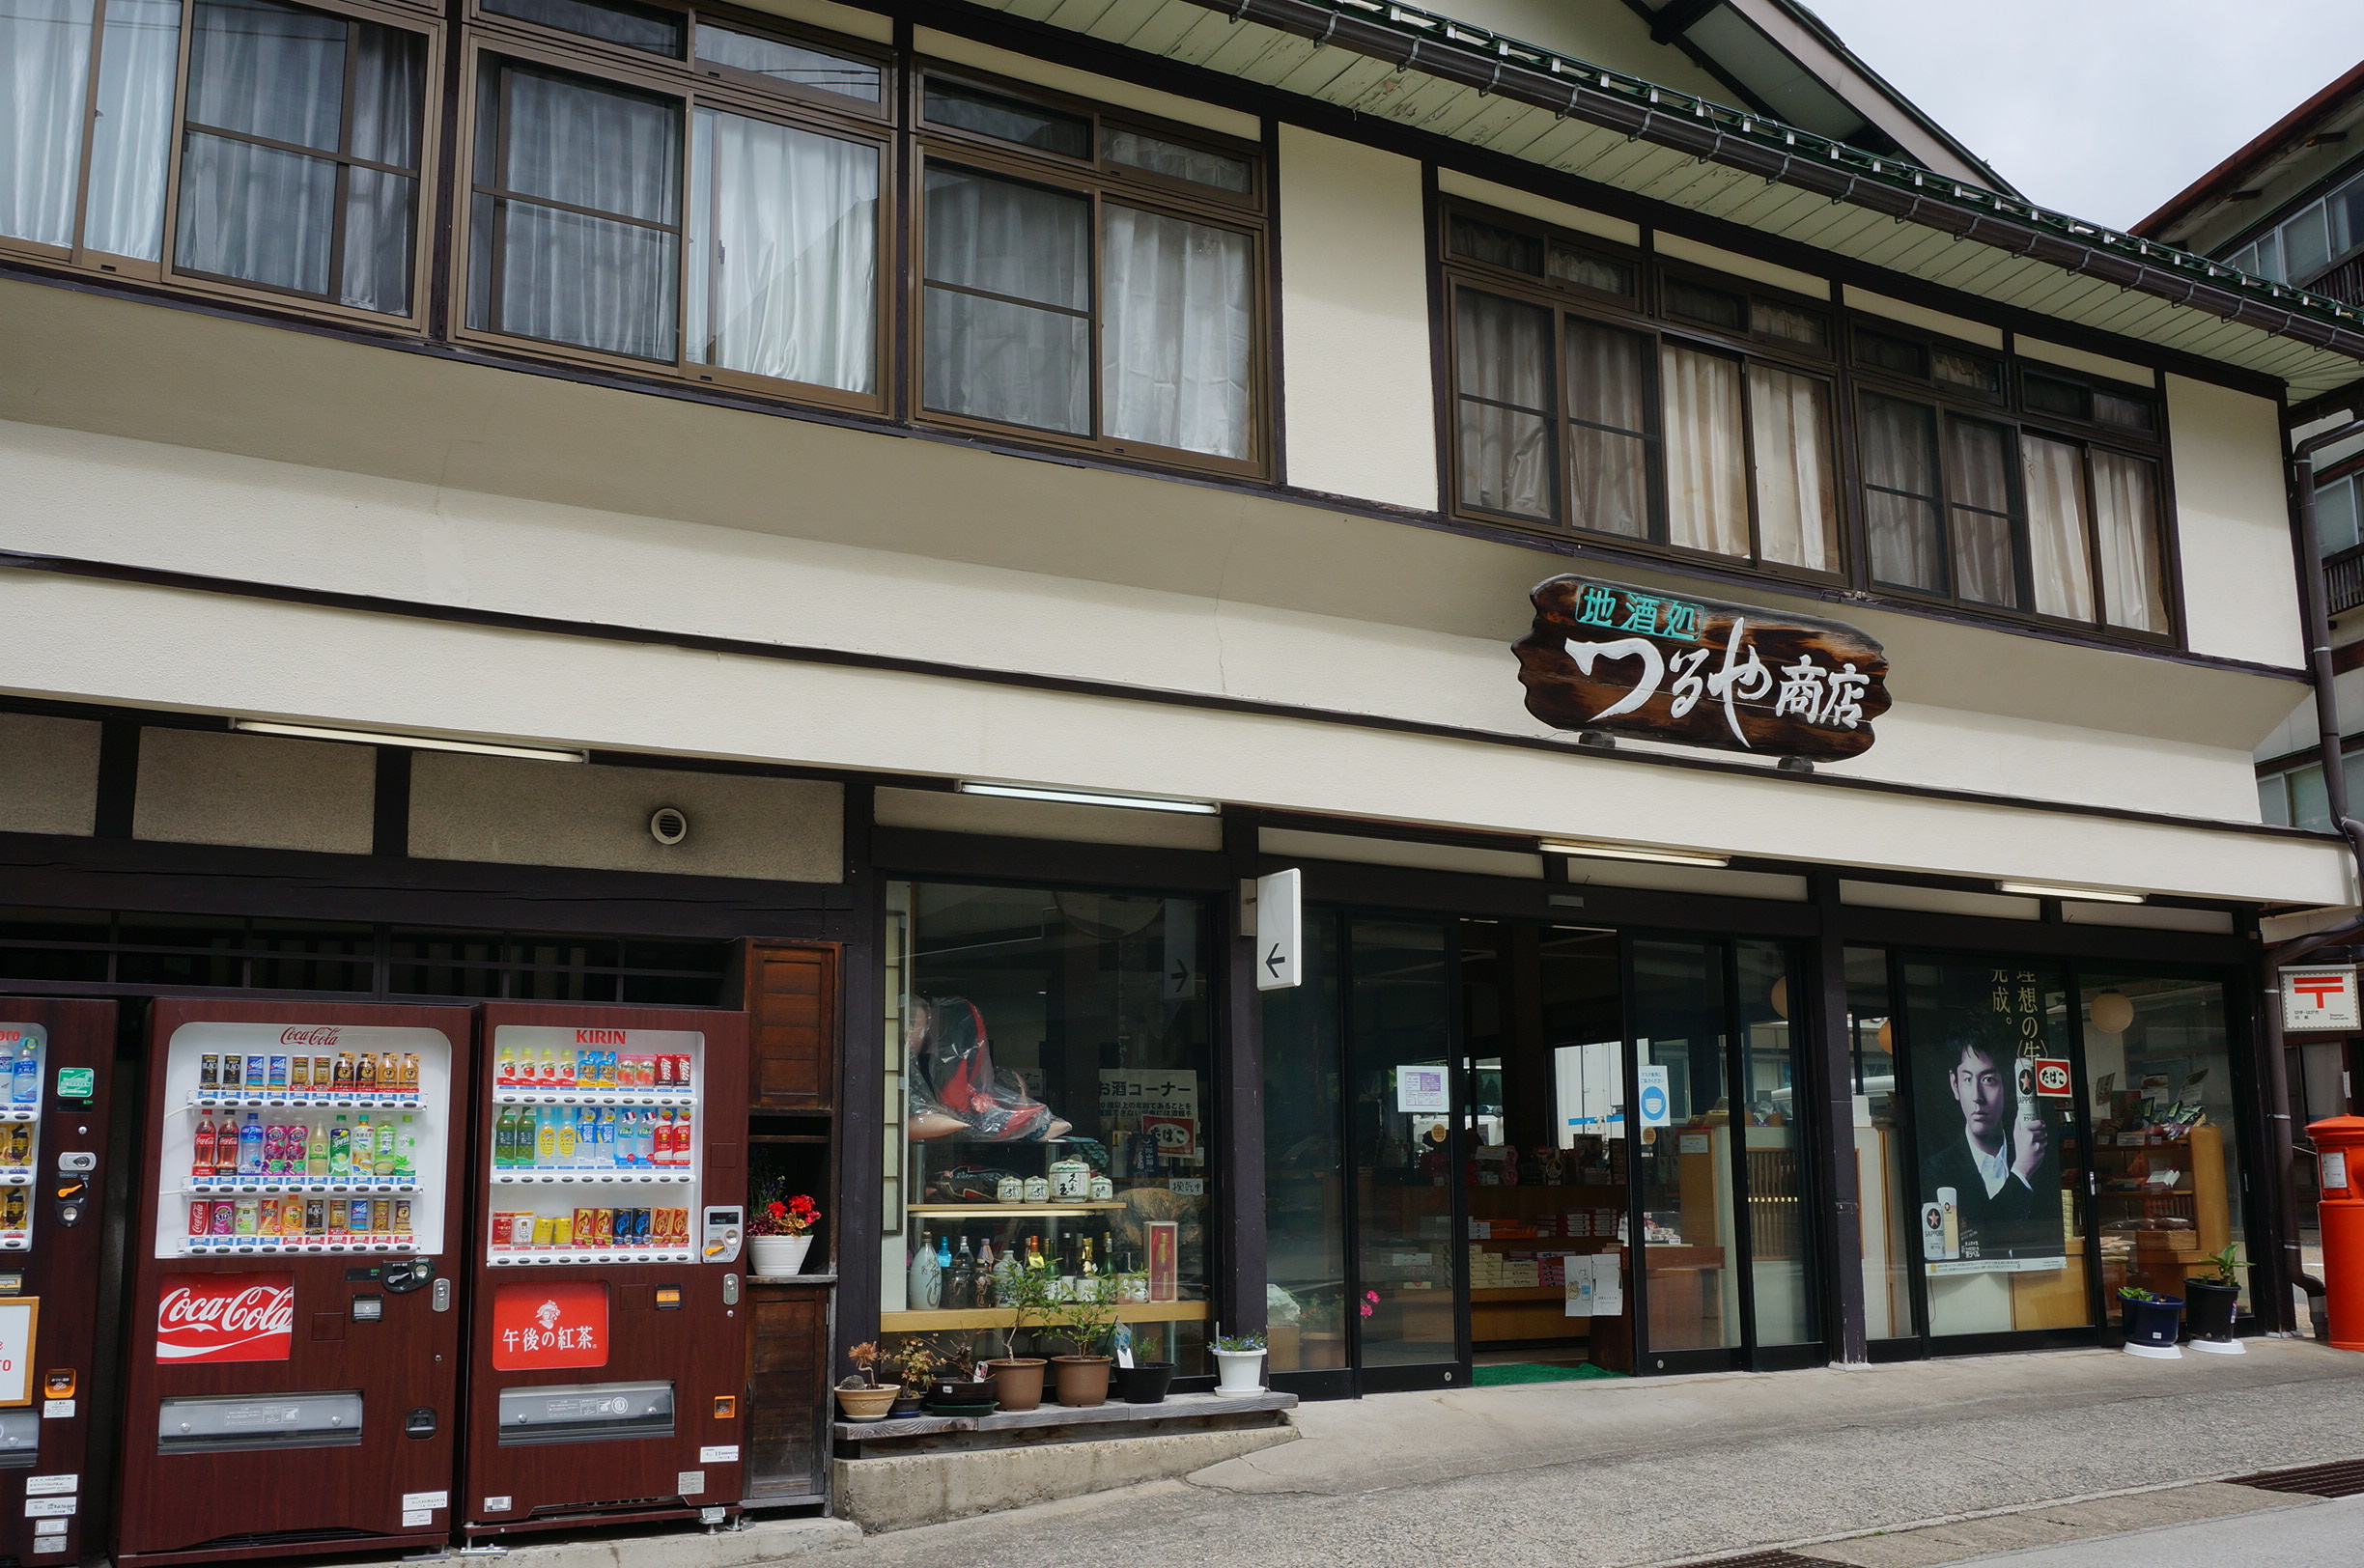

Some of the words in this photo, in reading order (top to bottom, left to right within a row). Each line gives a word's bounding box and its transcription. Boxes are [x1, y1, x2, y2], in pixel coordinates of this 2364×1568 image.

[1582, 586, 1696, 640] 地酒処
[1564, 617, 1871, 749] つるや商店
[280, 1026, 342, 1046] Coca-Cola
[576, 1029, 626, 1044] KIRIN
[2040, 1070, 2067, 1083] たばこ
[158, 1286, 294, 1332] Coca-Cola
[502, 1326, 594, 1353] 午後の紅茶
